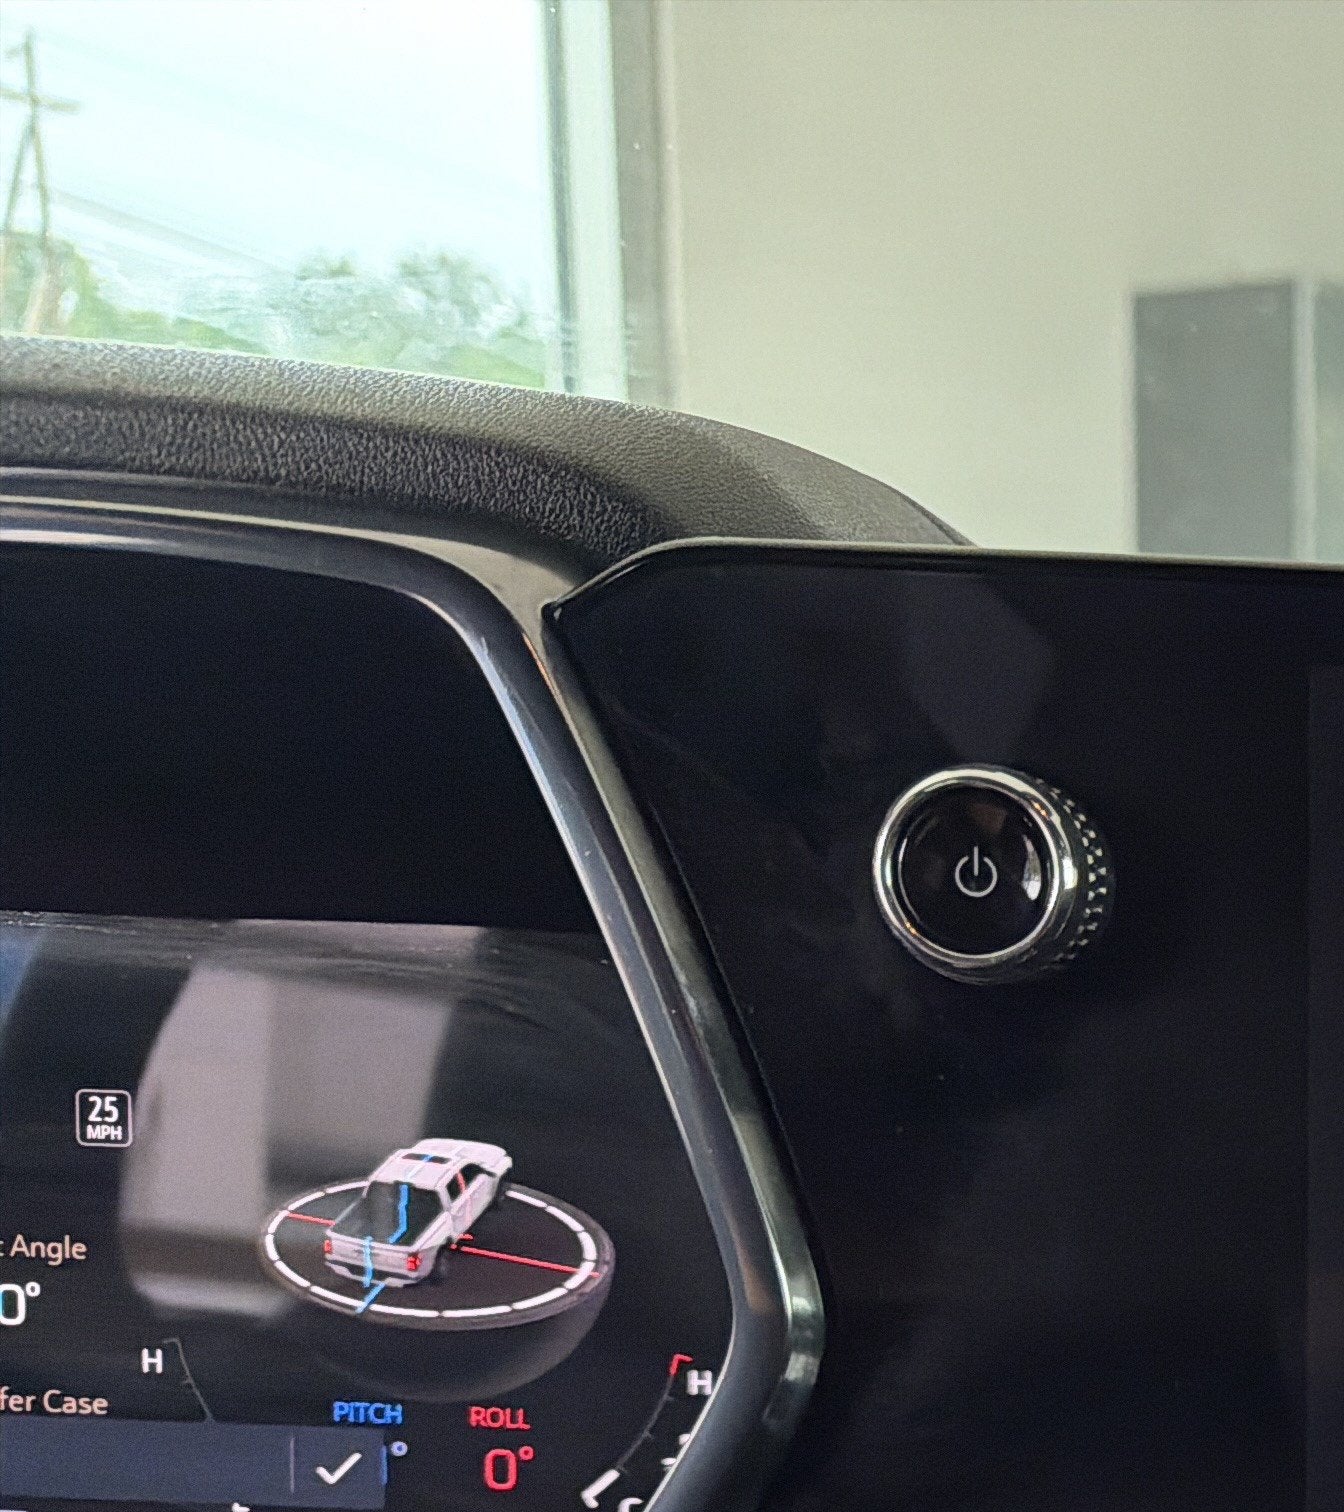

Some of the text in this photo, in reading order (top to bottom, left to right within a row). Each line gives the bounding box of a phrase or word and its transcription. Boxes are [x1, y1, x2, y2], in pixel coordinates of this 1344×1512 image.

[87, 1095, 119, 1123] 25
[86, 1124, 123, 1141] MPH
[9, 1233, 88, 1266] Angle
[141, 1347, 163, 1374] H
[686, 1369, 713, 1396] H
[43, 1389, 109, 1415] Case
[332, 1401, 403, 1425] PITCH
[469, 1405, 532, 1430] ROLL
